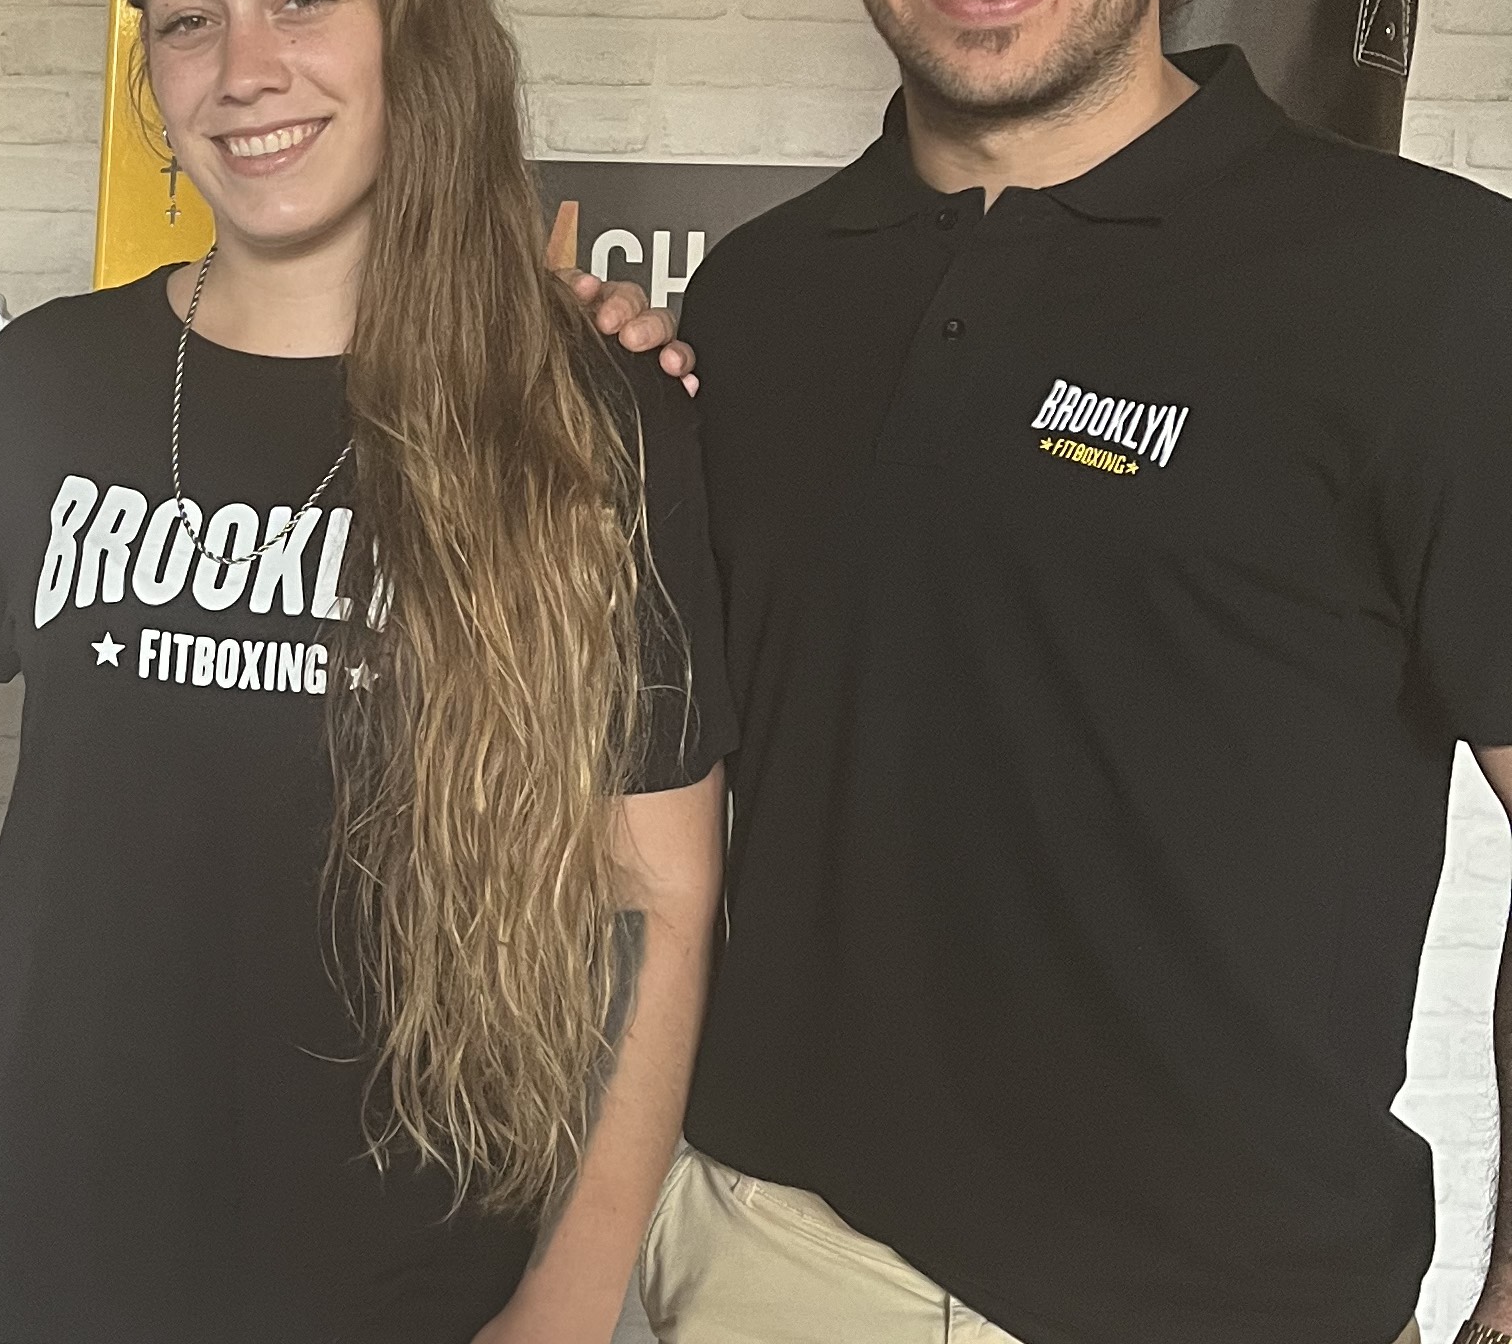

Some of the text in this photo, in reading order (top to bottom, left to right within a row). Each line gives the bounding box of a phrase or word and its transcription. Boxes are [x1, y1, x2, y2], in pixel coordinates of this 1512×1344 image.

[1031, 378, 1189, 468] BROOKLYN
[1052, 438, 1126, 475] FITBOXING
[34, 475, 395, 633] BROOKL
[138, 628, 328, 694] FITBOXING
